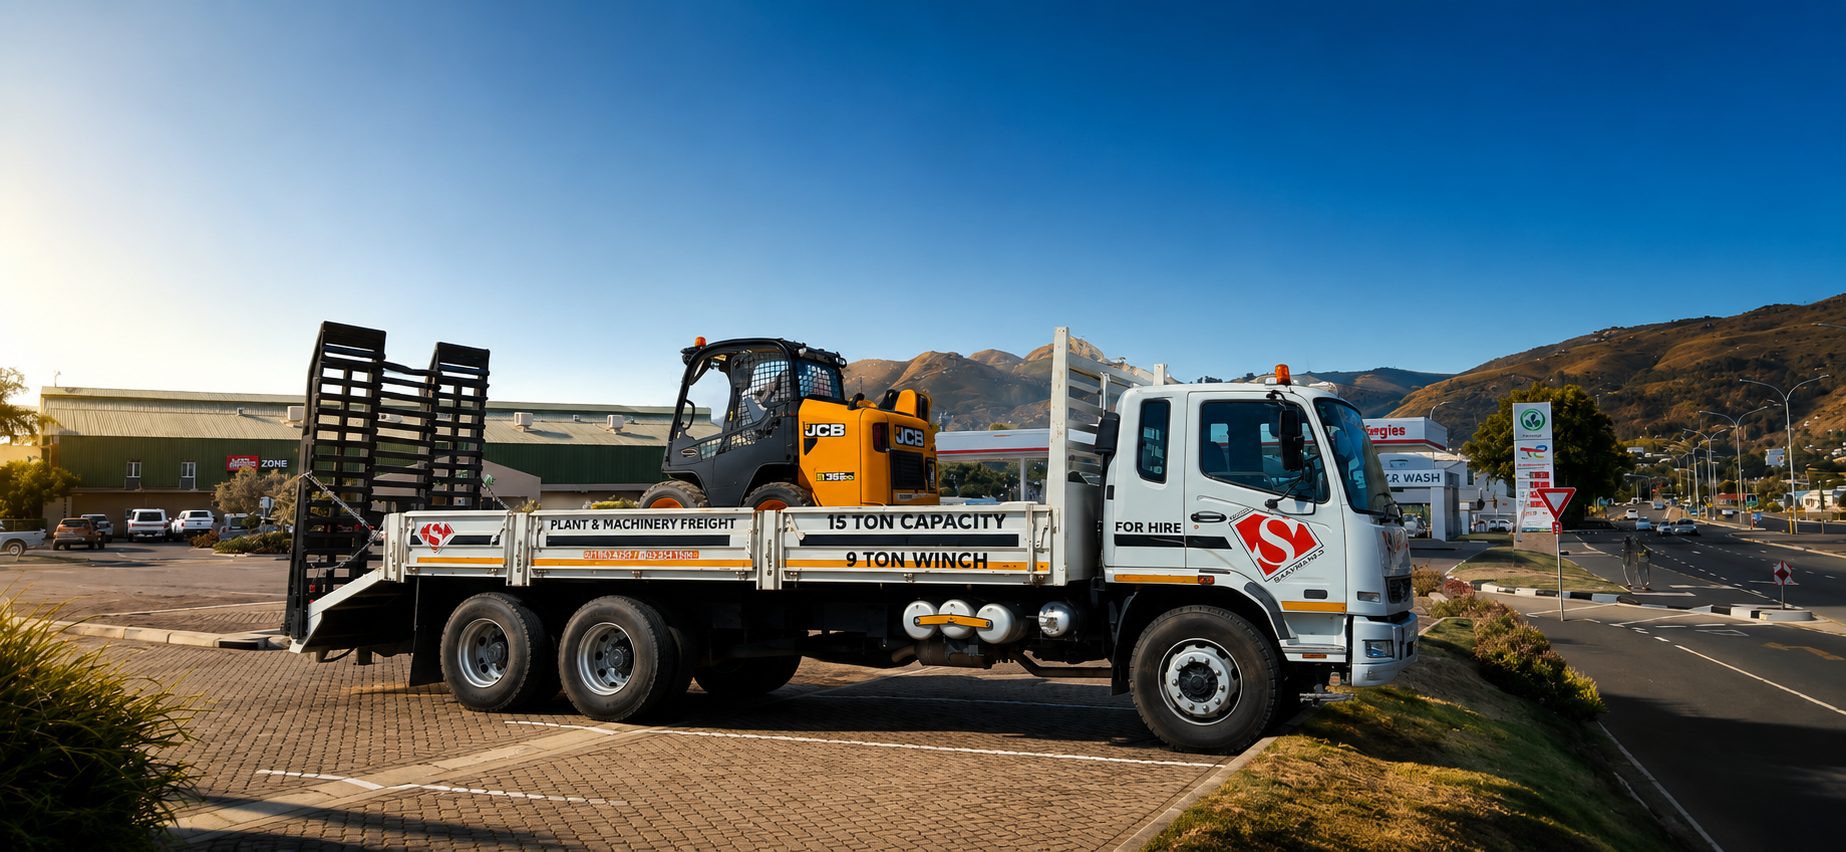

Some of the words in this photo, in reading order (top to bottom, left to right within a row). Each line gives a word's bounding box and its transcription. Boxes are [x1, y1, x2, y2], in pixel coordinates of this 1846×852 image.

[804, 424, 845, 437] JCB
[895, 427, 924, 447] JCB
[261, 459, 288, 468] ZONE
[1403, 473, 1440, 483] WASH
[550, 519, 589, 530] PLANT
[591, 519, 600, 530] &
[603, 518, 678, 530] MACHINERY
[681, 518, 736, 530] FREIGHT
[827, 514, 847, 530] 15
[852, 514, 894, 530] TON
[900, 513, 1006, 530] CAPACITY
[1115, 521, 1144, 533] FOR
[1148, 522, 1182, 533] HIRE
[846, 551, 857, 567] 9
[863, 551, 905, 568] TON
[912, 552, 988, 569] WINCH
